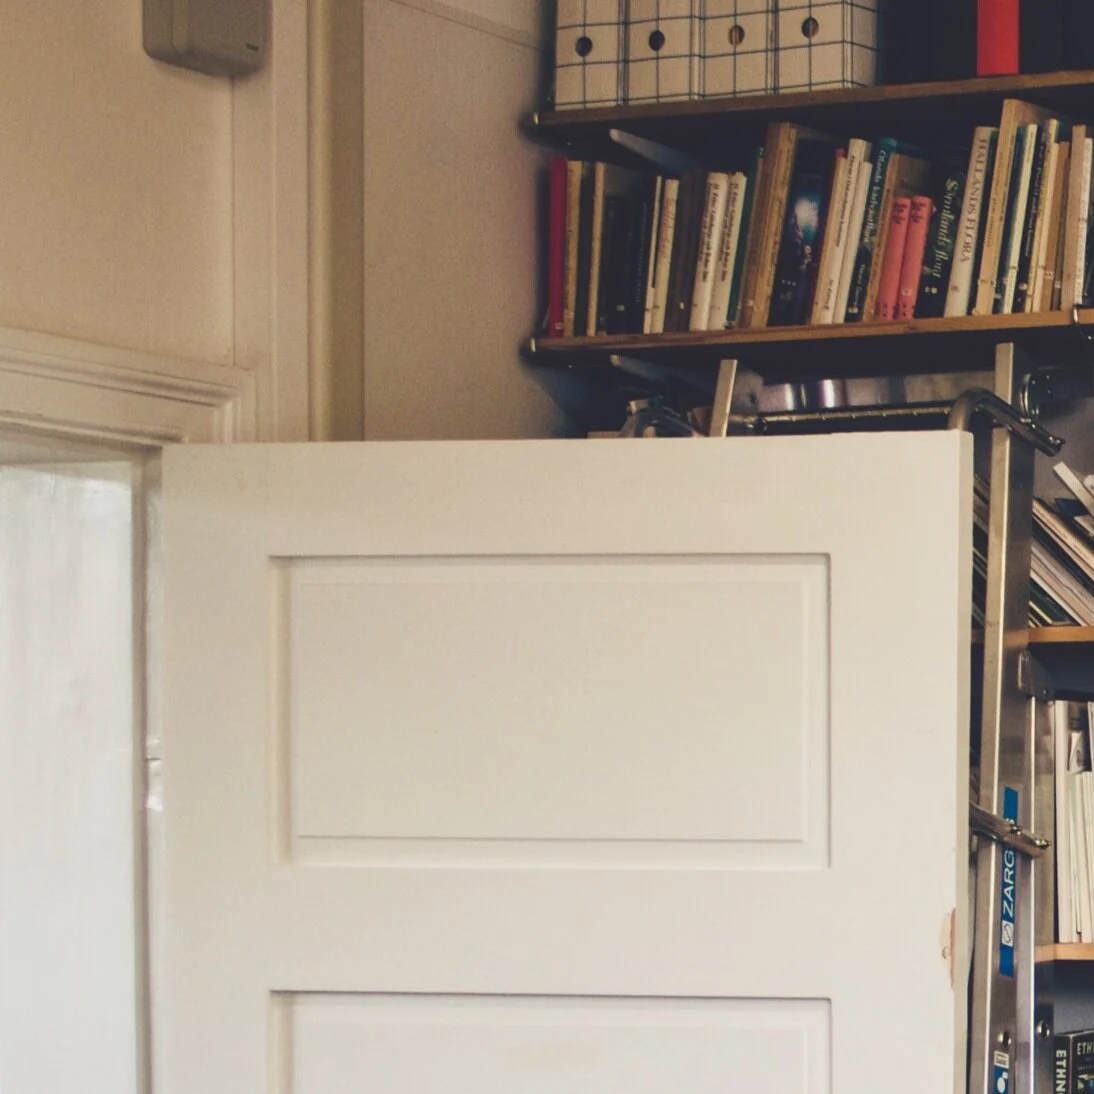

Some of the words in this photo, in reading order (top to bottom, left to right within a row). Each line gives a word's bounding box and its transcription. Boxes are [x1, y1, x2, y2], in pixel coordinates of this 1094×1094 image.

[968, 138, 986, 215] HALLANDS
[961, 218, 977, 263] FLORA
[1003, 819, 1014, 918] ZARGS
